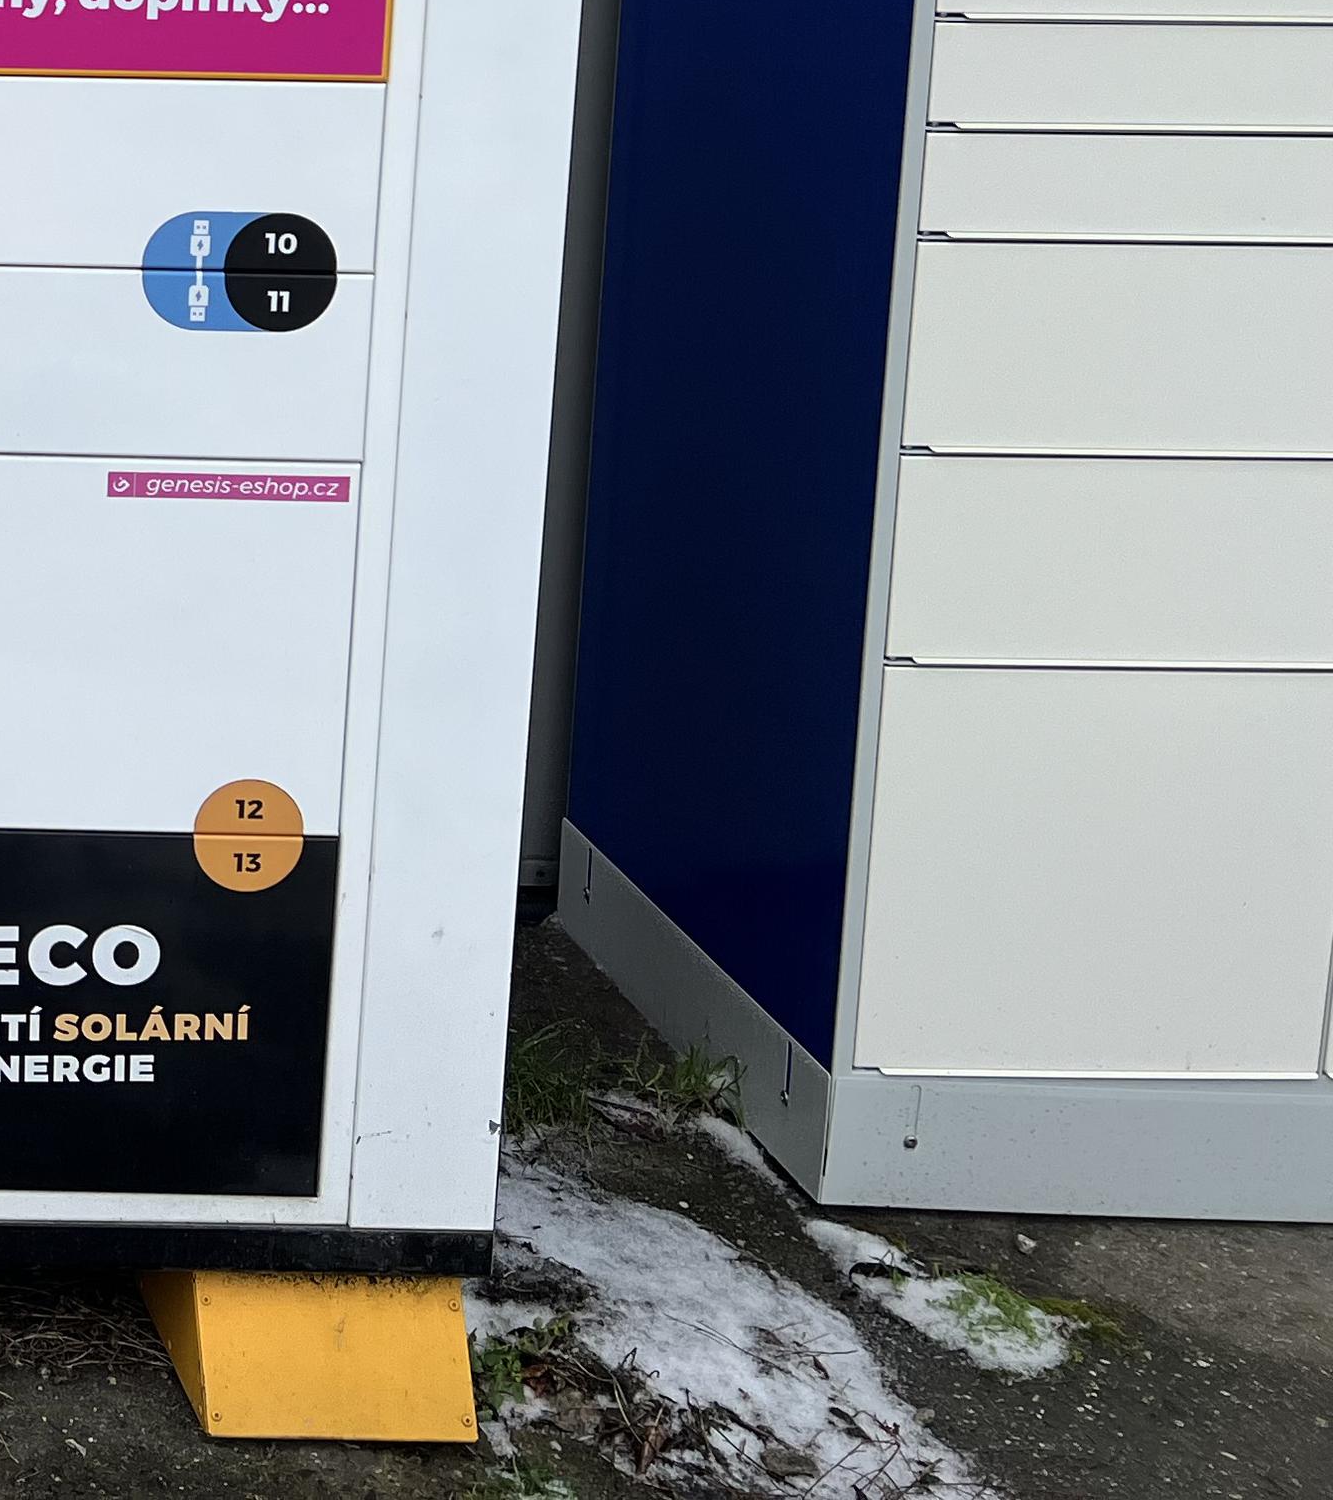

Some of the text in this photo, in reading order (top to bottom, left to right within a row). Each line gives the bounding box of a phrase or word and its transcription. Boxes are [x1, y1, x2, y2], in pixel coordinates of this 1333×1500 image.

[265, 233, 297, 254] 10
[268, 291, 289, 312] 11
[145, 476, 340, 499] genesis-eshop.cz
[236, 800, 263, 819] 12
[234, 853, 260, 872] 13
[53, 1005, 251, 1041] SOLÁRNÍ
